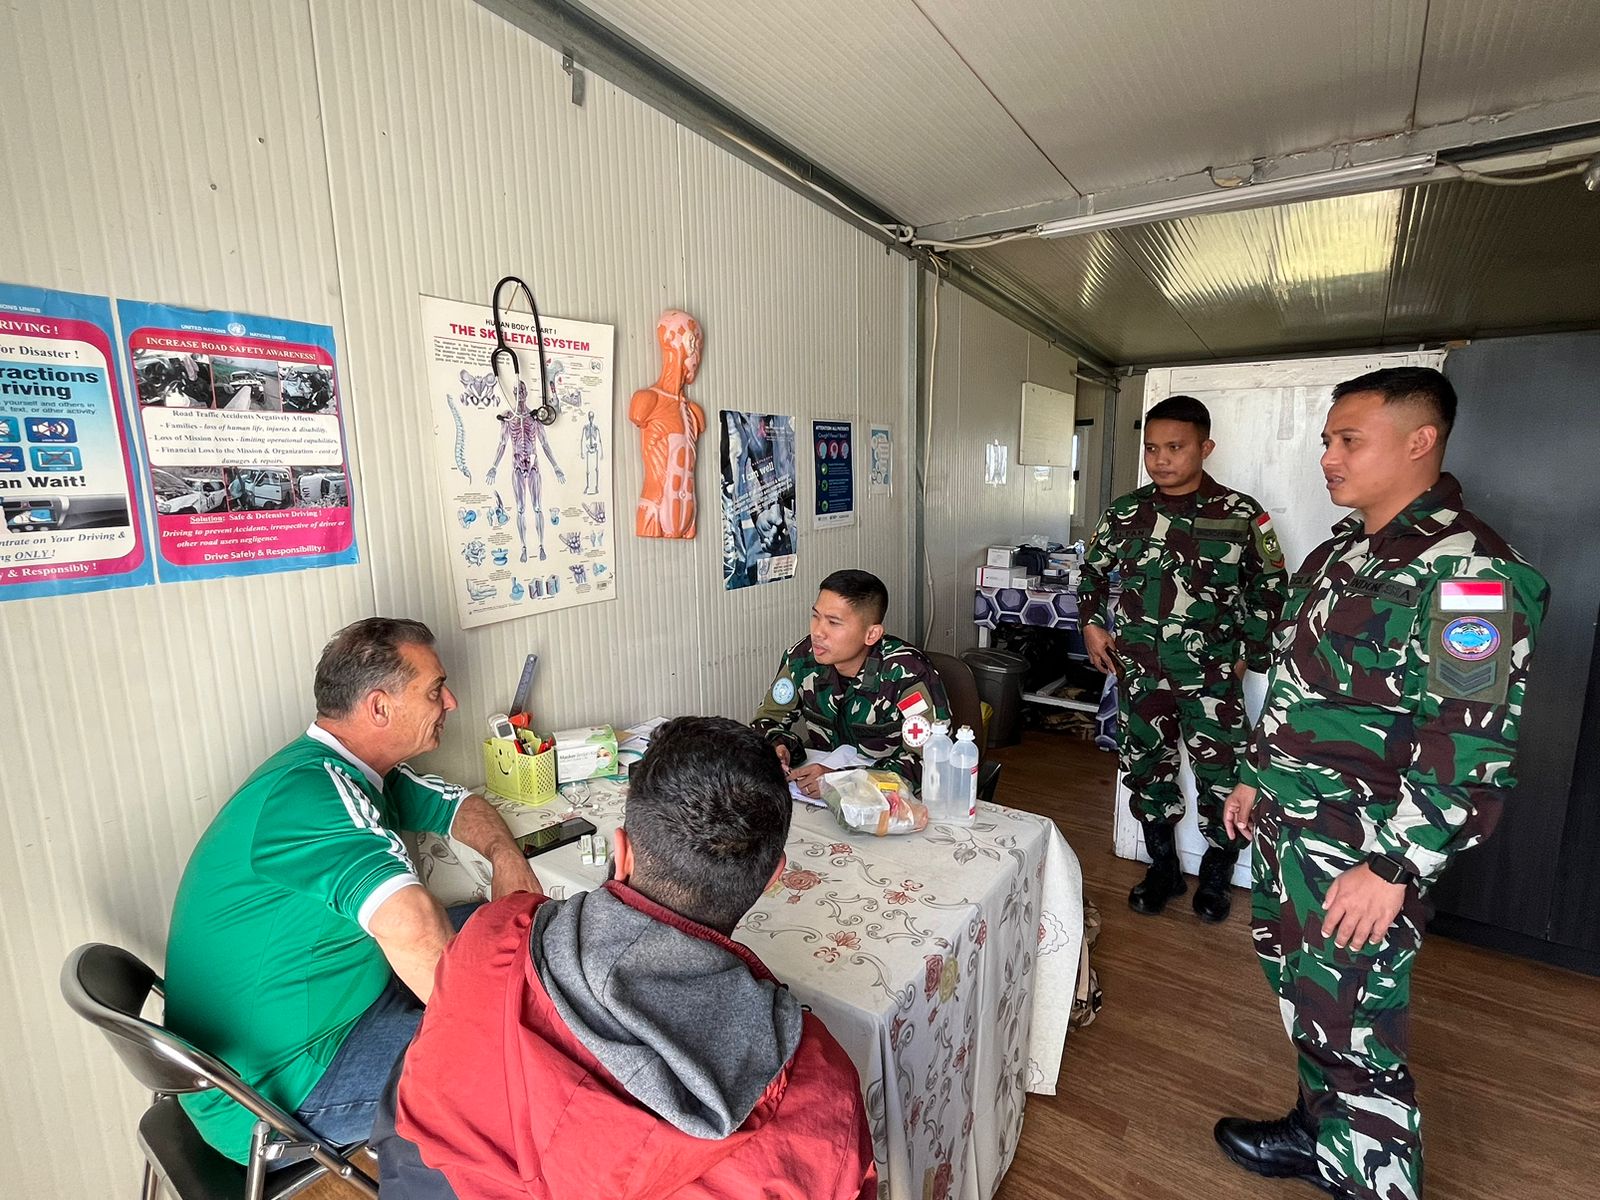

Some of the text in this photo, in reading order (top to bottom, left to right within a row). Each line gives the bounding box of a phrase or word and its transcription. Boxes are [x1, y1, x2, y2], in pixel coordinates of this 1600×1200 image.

[0, 320, 51, 334] RIVING
[203, 326, 226, 334] NATIONS
[486, 319, 510, 328] HUAN
[512, 322, 530, 332] BODY
[530, 326, 554, 334] CART
[450, 323, 476, 336] THE
[544, 338, 590, 352] SYSTEM
[0, 343, 16, 354] or
[19, 345, 71, 359] Disaster
[146, 336, 316, 360] INCREASE ROAD SAFETY AWARENESS!
[0, 367, 100, 384] ractions
[0, 380, 72, 400] riving
[256, 414, 290, 422] Negatively
[760, 461, 775, 475] well
[27, 476, 86, 488] Wait!
[302, 487, 310, 498] UN
[190, 516, 226, 524] Solution:
[204, 528, 232, 536] prevent
[234, 525, 269, 533] Accidents,
[270, 522, 309, 530] irrespective
[78, 532, 115, 542] Driving
[240, 536, 278, 544] negligence.
[14, 550, 48, 561] ONLY
[230, 550, 256, 558] Safely
[266, 544, 322, 556] Responsibility
[8, 570, 18, 578] &
[22, 564, 90, 577] Responsibly
